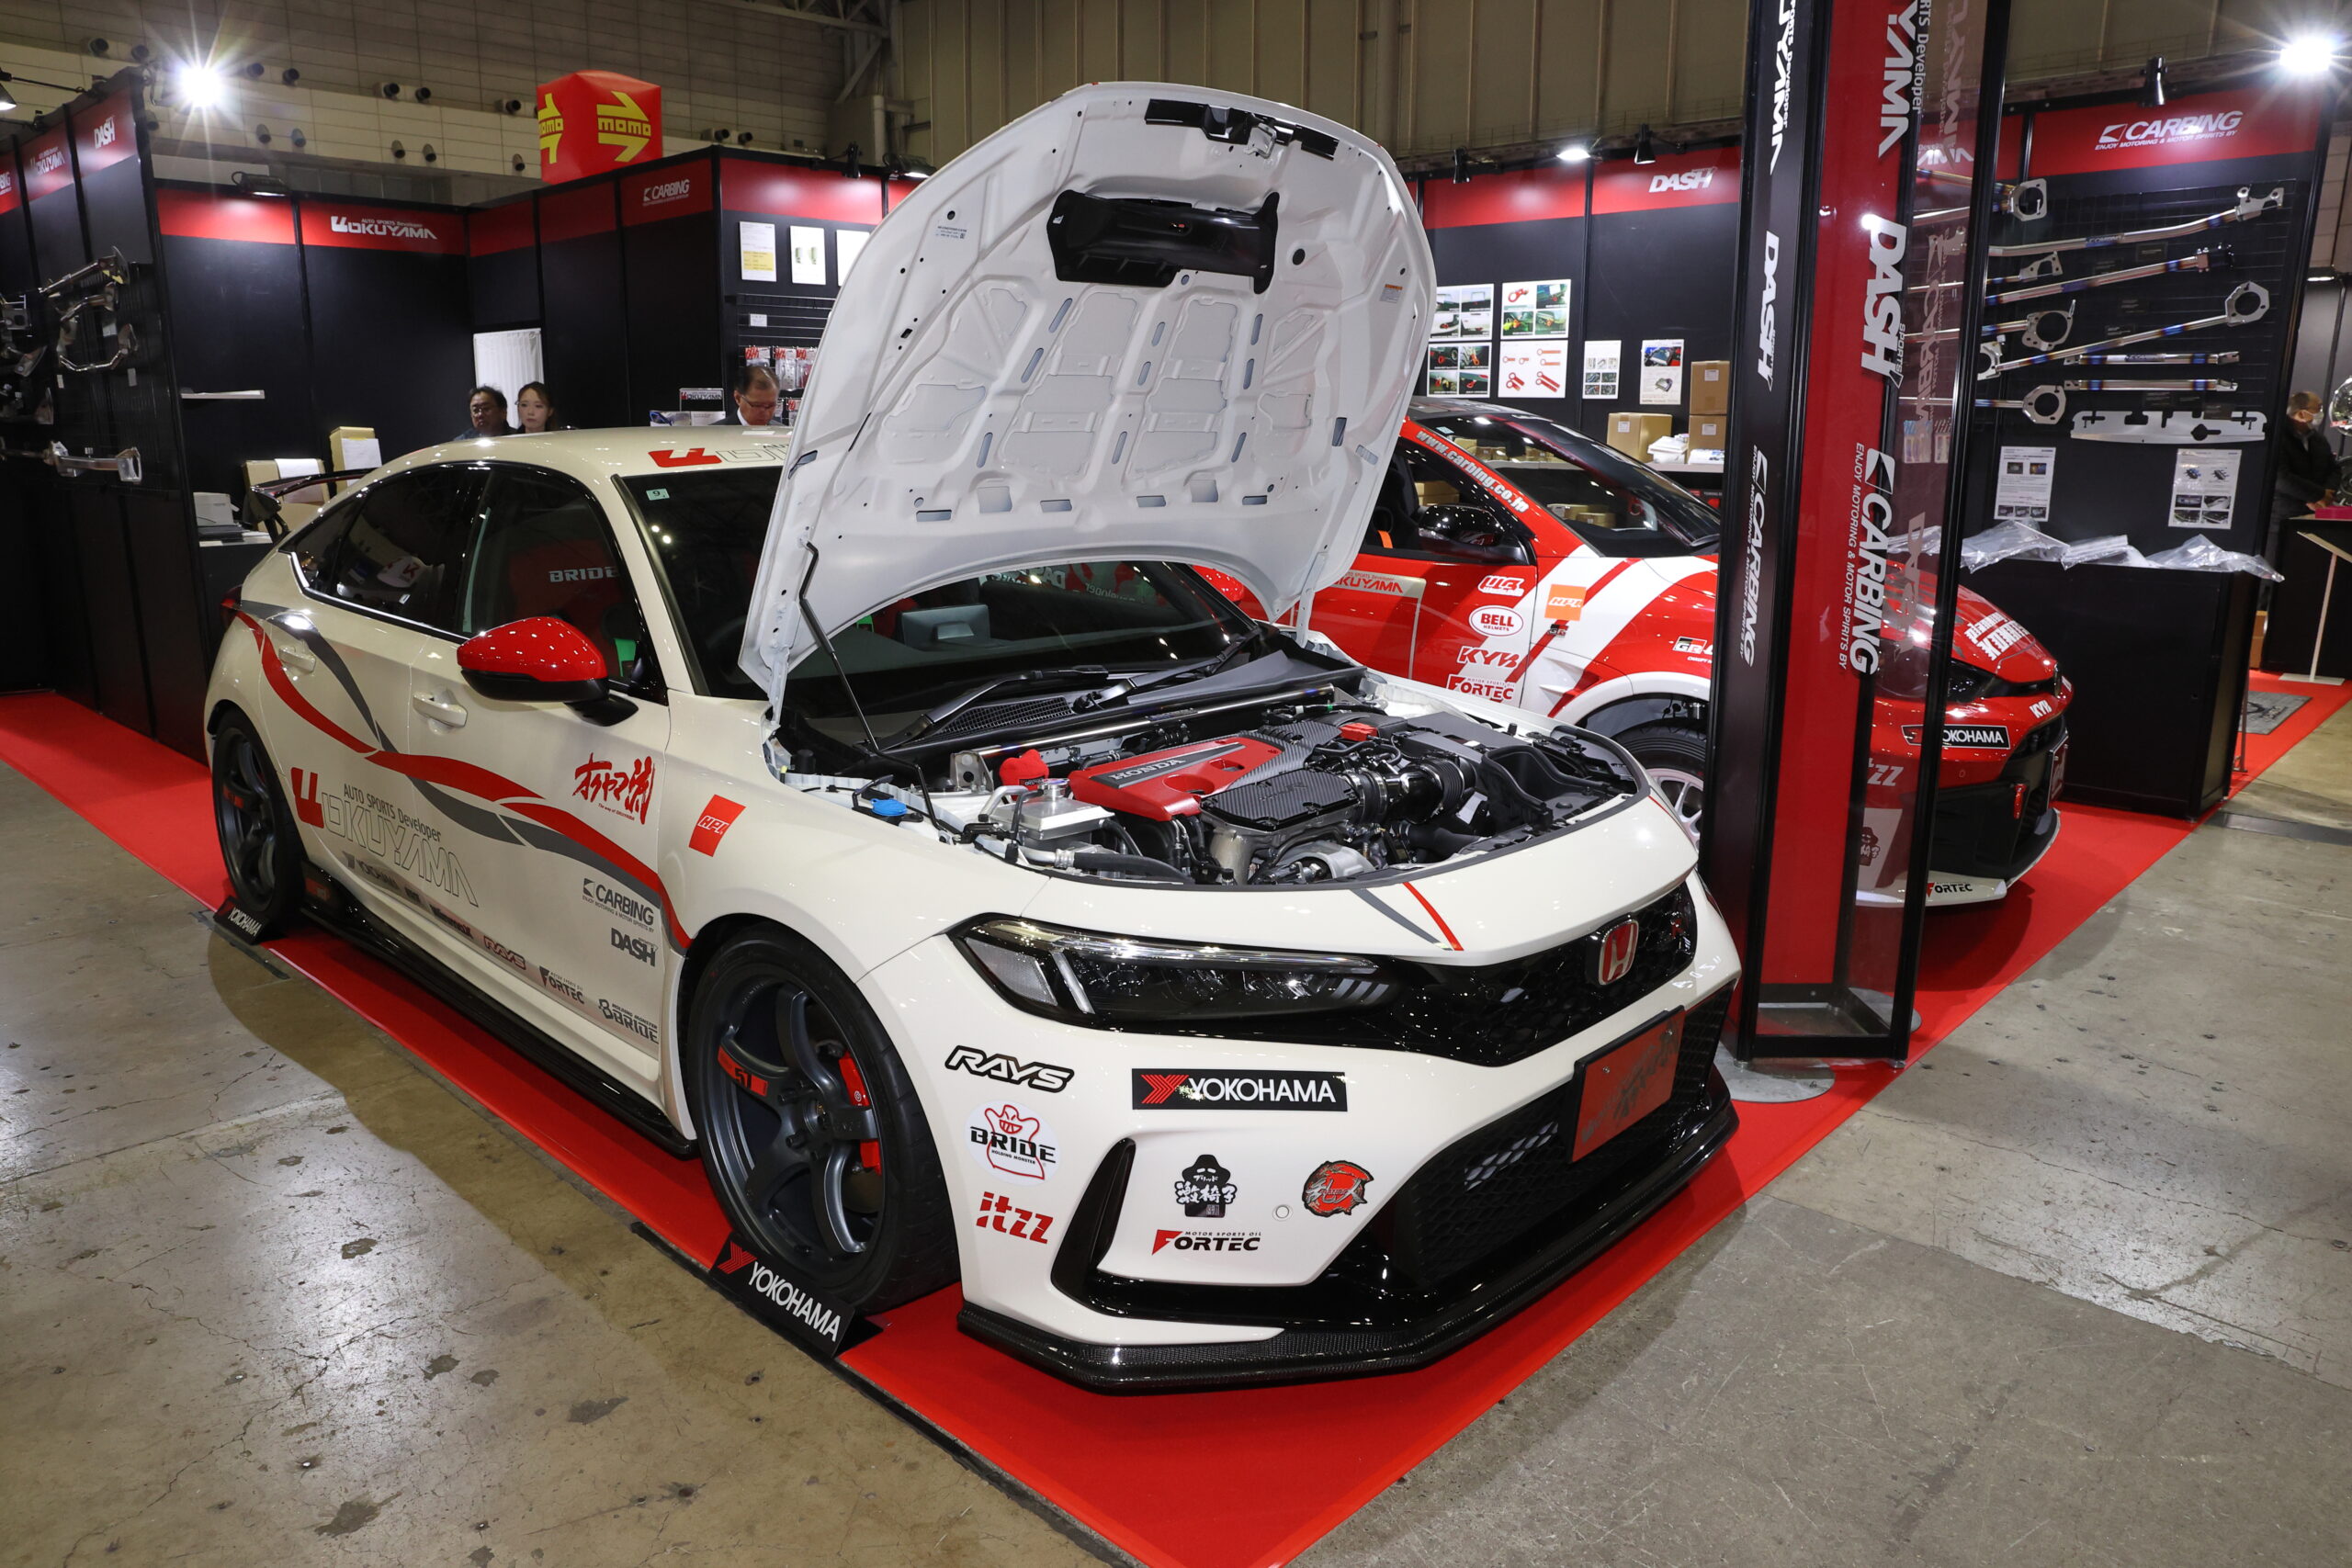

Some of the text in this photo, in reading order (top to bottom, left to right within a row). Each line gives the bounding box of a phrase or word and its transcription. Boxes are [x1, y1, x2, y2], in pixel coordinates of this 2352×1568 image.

[1782, 51, 1792, 128] Developer
[1912, 33, 1928, 114] Developer
[93, 116, 116, 150] DASH
[598, 118, 651, 136] momo
[2125, 110, 2244, 141] CARBING
[2095, 142, 2119, 151] ENJOY
[2120, 139, 2158, 148] MOTORING
[651, 179, 690, 199] CARBING
[1648, 171, 1713, 193] DASH
[348, 221, 437, 240] OKUYAMA
[1757, 230, 1780, 385] DASH
[1860, 214, 1906, 378] DASH
[1894, 323, 1905, 373] SPORTS
[1416, 430, 1530, 513] www.carbing.co.jp
[1853, 443, 1864, 484] ENJOY
[1848, 485, 1860, 548] MOTORING
[548, 566, 619, 582] BRIDE
[1334, 576, 1404, 593] KUYAMA
[1745, 492, 1766, 667] CARBING
[1844, 561, 1856, 604] MOTOR
[1849, 492, 1893, 675] CARBING
[1480, 613, 1514, 627] BELL
[1840, 604, 1851, 651] SPIRITS
[1458, 646, 1520, 669] KYB
[1838, 652, 1848, 670] BY
[1447, 674, 1514, 701] FORTEC
[1943, 729, 2005, 743] OKOHAMA
[1113, 759, 1186, 781] HONDA
[344, 783, 441, 842] AUTO SPORTS Developer
[322, 792, 479, 908] OKUYAMA
[595, 884, 654, 926] CARBING
[1926, 882, 1973, 897] FORTEC
[227, 907, 263, 937] YOKOHAMA
[483, 934, 526, 970] RAYS
[611, 927, 656, 967] DASH
[539, 965, 585, 1005] FORTEC
[945, 1044, 1075, 1093] RAYS
[1188, 1077, 1337, 1102] YOKOHAMA
[970, 1126, 1056, 1164] BRIDE
[991, 1150, 1036, 1165] HOLDING MONSTER
[976, 1191, 1054, 1245] itzz
[1151, 1229, 1261, 1256] FORTEC
[748, 1260, 842, 1342] YOKOHAMA
